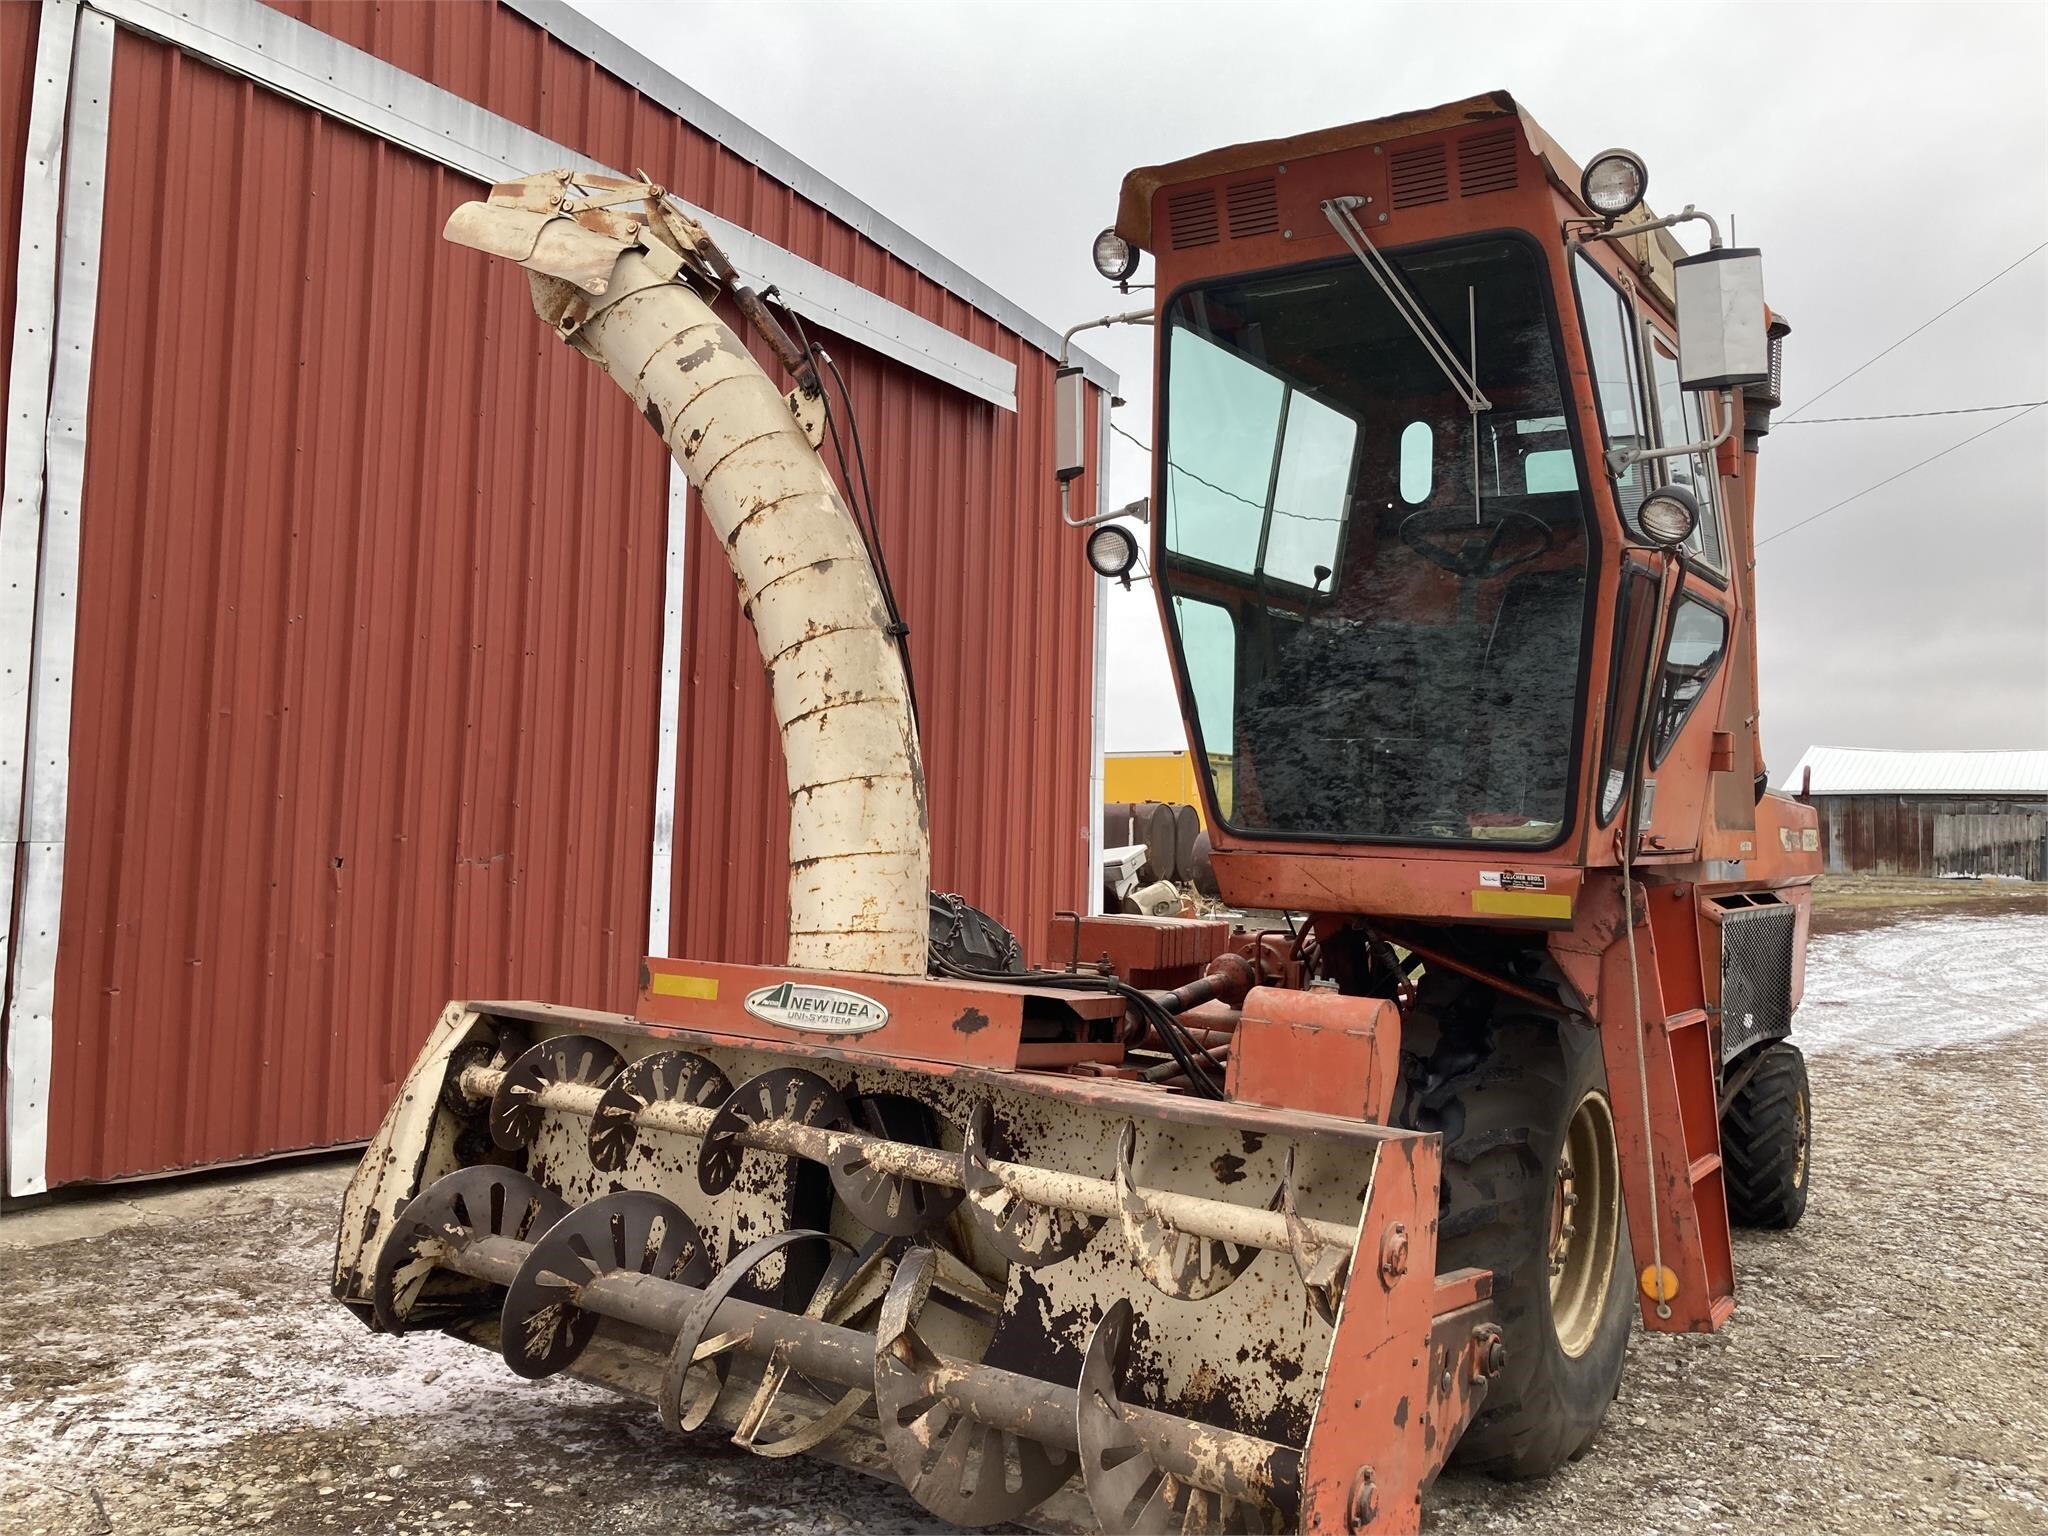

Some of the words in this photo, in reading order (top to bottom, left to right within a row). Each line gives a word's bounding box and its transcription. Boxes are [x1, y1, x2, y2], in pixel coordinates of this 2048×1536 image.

[790, 997, 829, 1012] NEW
[831, 1001, 870, 1017] IDEA
[787, 1011, 851, 1025] UNI-SYSTEM
